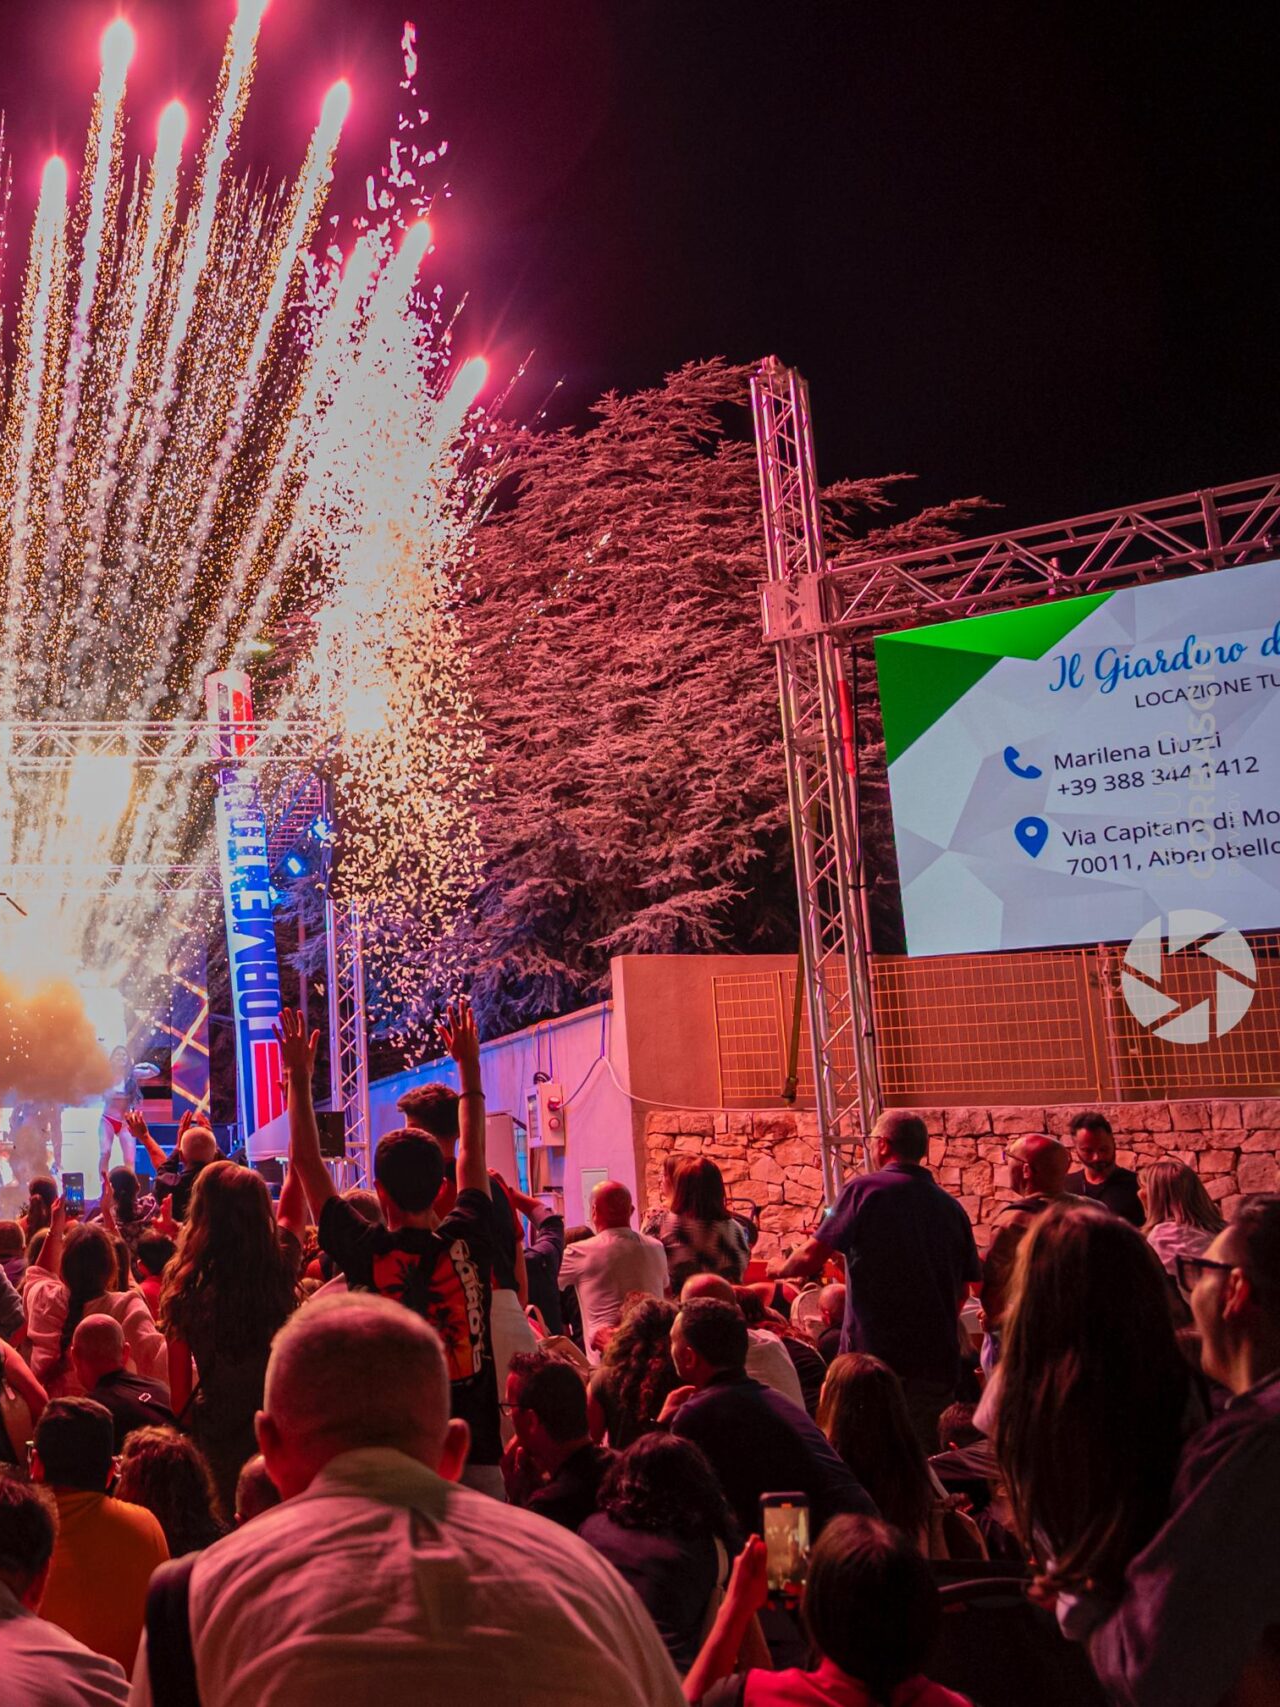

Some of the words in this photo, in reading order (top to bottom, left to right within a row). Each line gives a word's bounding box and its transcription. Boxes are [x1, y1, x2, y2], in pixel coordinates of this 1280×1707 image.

[1135, 676, 1253, 708] LOCAZIONE
[1054, 744, 1151, 770] Marilena
[1157, 732, 1222, 756] Liuzzi
[1057, 778, 1097, 796] +39
[1103, 771, 1145, 791] 388
[1062, 829, 1096, 847] Via
[1104, 819, 1206, 845] Capitano
[1213, 811, 1235, 830] di
[1242, 808, 1280, 827] Mo
[1066, 853, 1142, 876] 70011,
